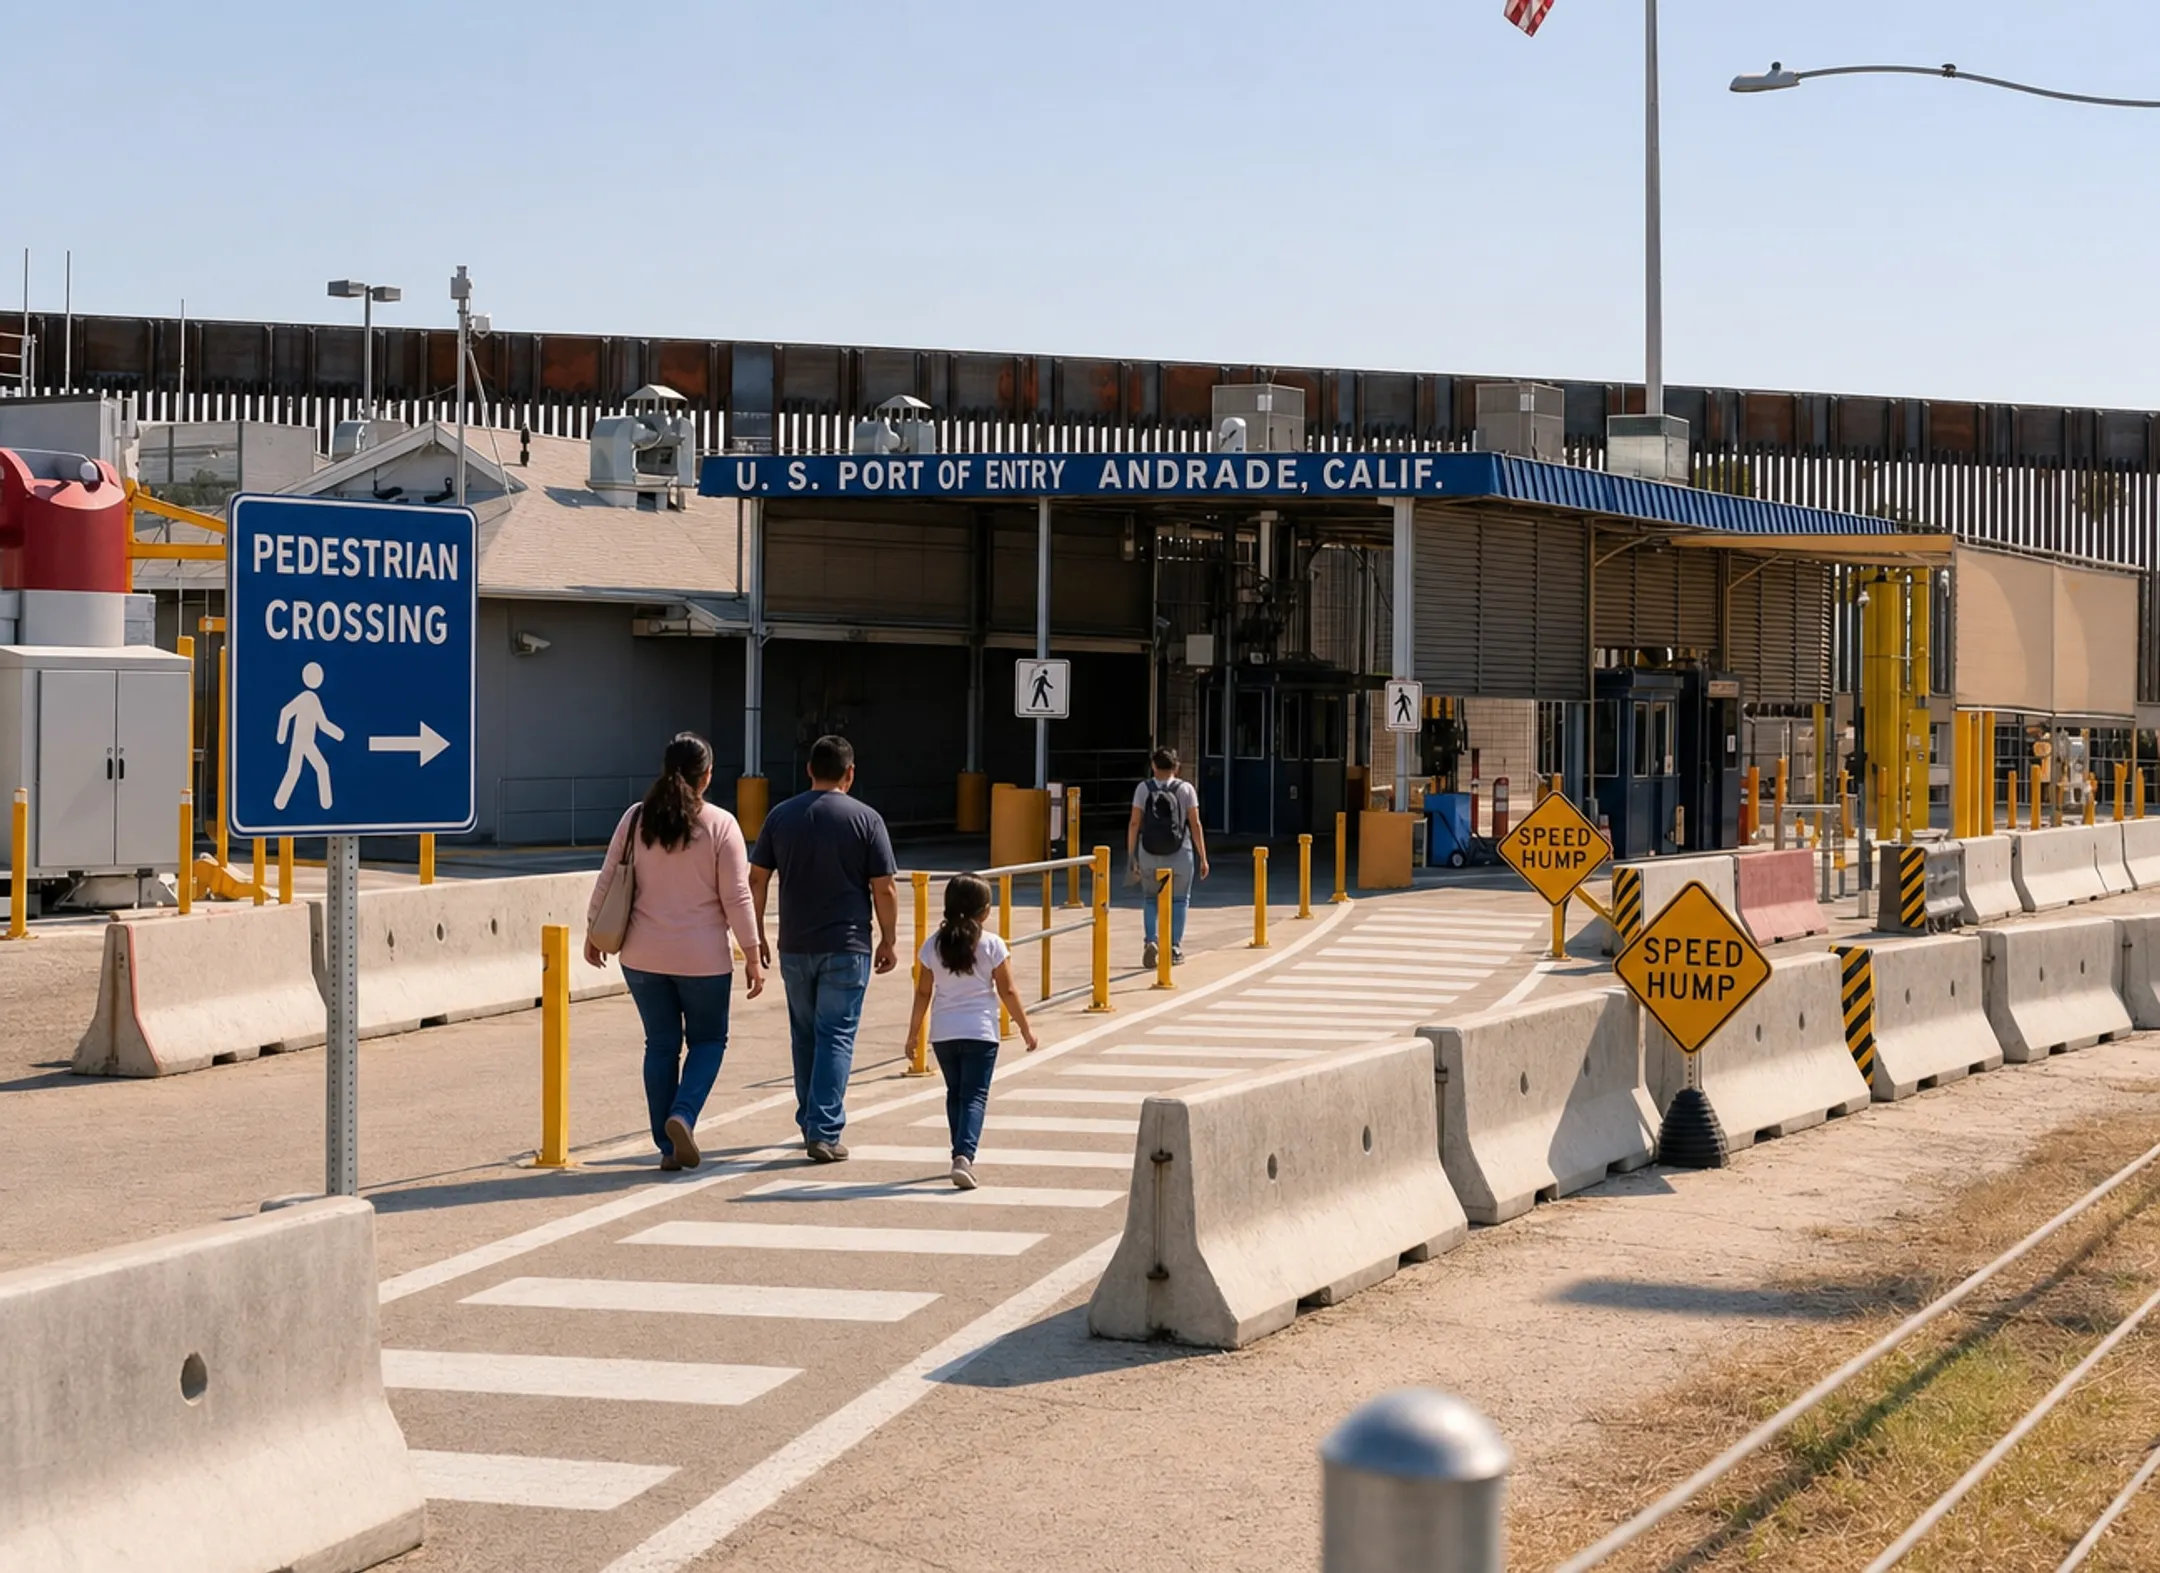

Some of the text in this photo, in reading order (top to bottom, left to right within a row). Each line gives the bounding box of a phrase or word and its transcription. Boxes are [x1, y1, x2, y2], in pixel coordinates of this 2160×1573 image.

[736, 458, 1443, 493] U. S. PORT OF ENTRY ANDRADE, CALIF.
[253, 533, 458, 581] PEDESTRIAN
[265, 599, 448, 645] CROSSING
[1518, 826, 1591, 847] SPEED
[1521, 849, 1587, 869] HUMP
[1643, 936, 1744, 968] SPEED
[1647, 971, 1736, 1001] HUMP
